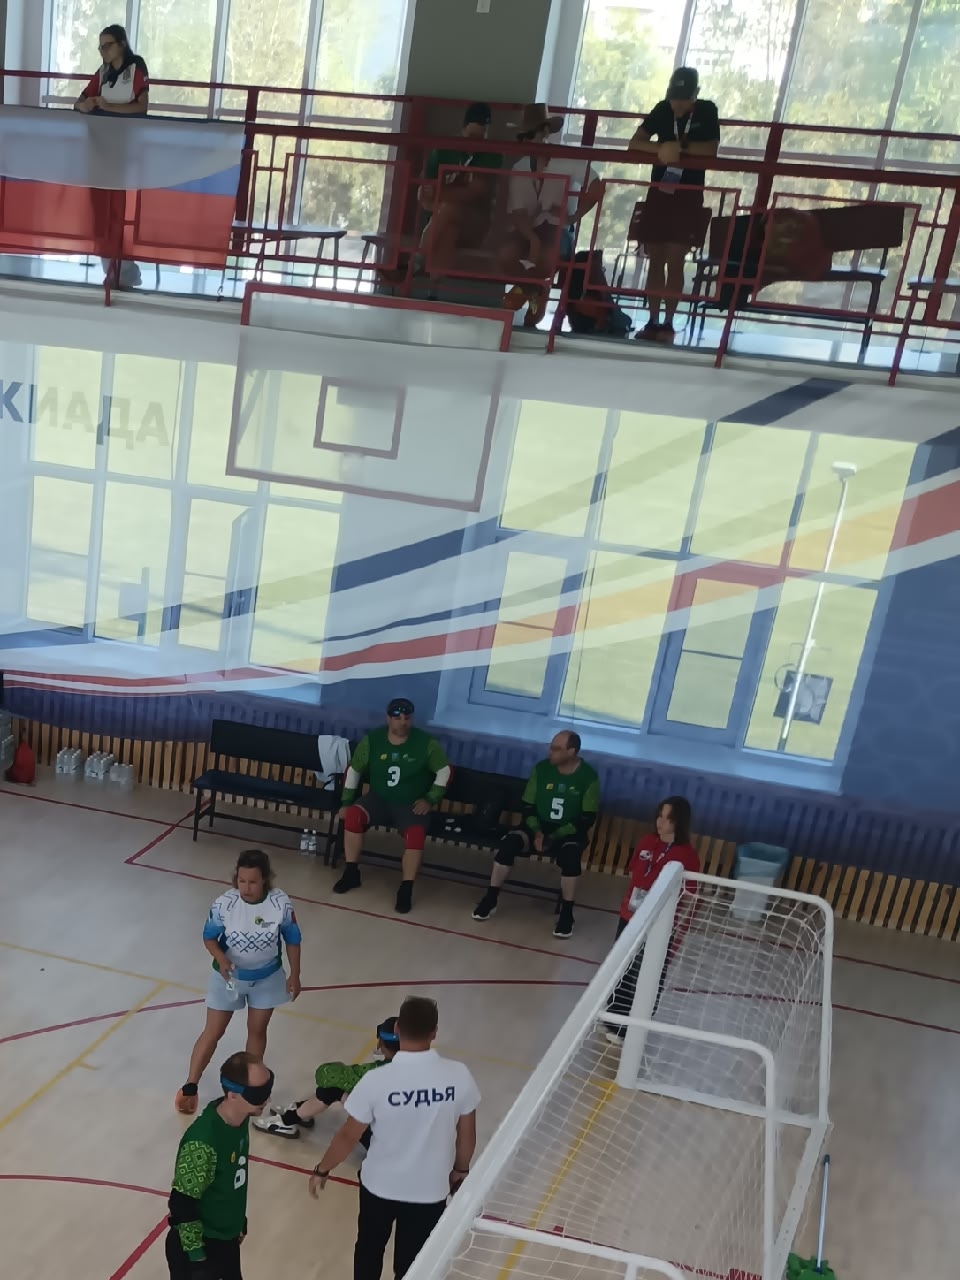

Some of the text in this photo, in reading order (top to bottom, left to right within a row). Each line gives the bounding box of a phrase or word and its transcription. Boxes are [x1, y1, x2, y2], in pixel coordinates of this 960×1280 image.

[387, 765, 401, 788] 3
[550, 797, 565, 820] 5
[387, 1086, 456, 1109] СУДЬЯ
